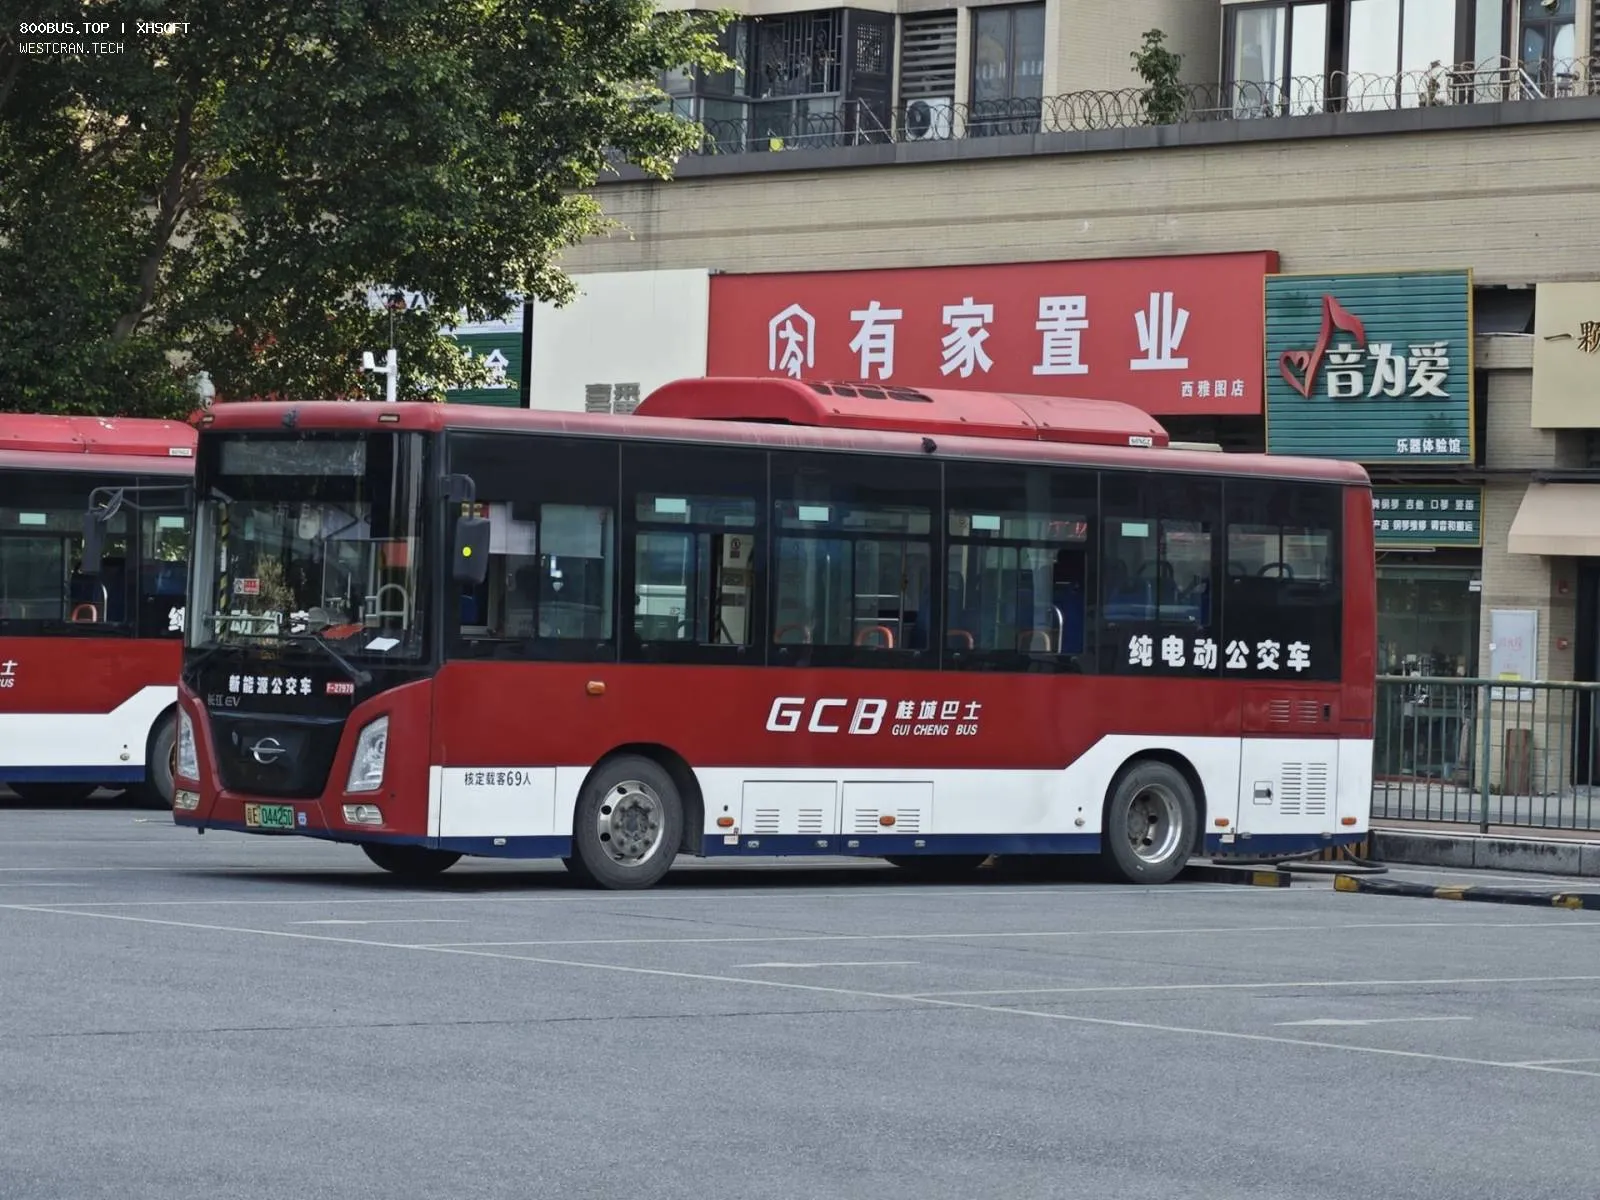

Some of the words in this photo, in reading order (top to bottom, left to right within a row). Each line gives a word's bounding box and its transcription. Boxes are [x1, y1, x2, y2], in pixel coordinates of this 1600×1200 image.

[849, 291, 1190, 381] 有家置业
[1325, 341, 1451, 398] 音为爱
[1181, 379, 1244, 398] 西雅图店
[1396, 437, 1461, 454] 乐器体验馆
[1128, 634, 1311, 672] 纯电动公交车
[0, 678, 15, 688] US
[228, 674, 312, 696] 新能源公交车
[766, 697, 888, 735] GCB
[894, 700, 982, 720] 桂城巴士
[891, 724, 911, 736] GUI
[913, 724, 949, 736] CHENG
[955, 724, 979, 736] BUS
[464, 770, 532, 787] 核定载客69人
